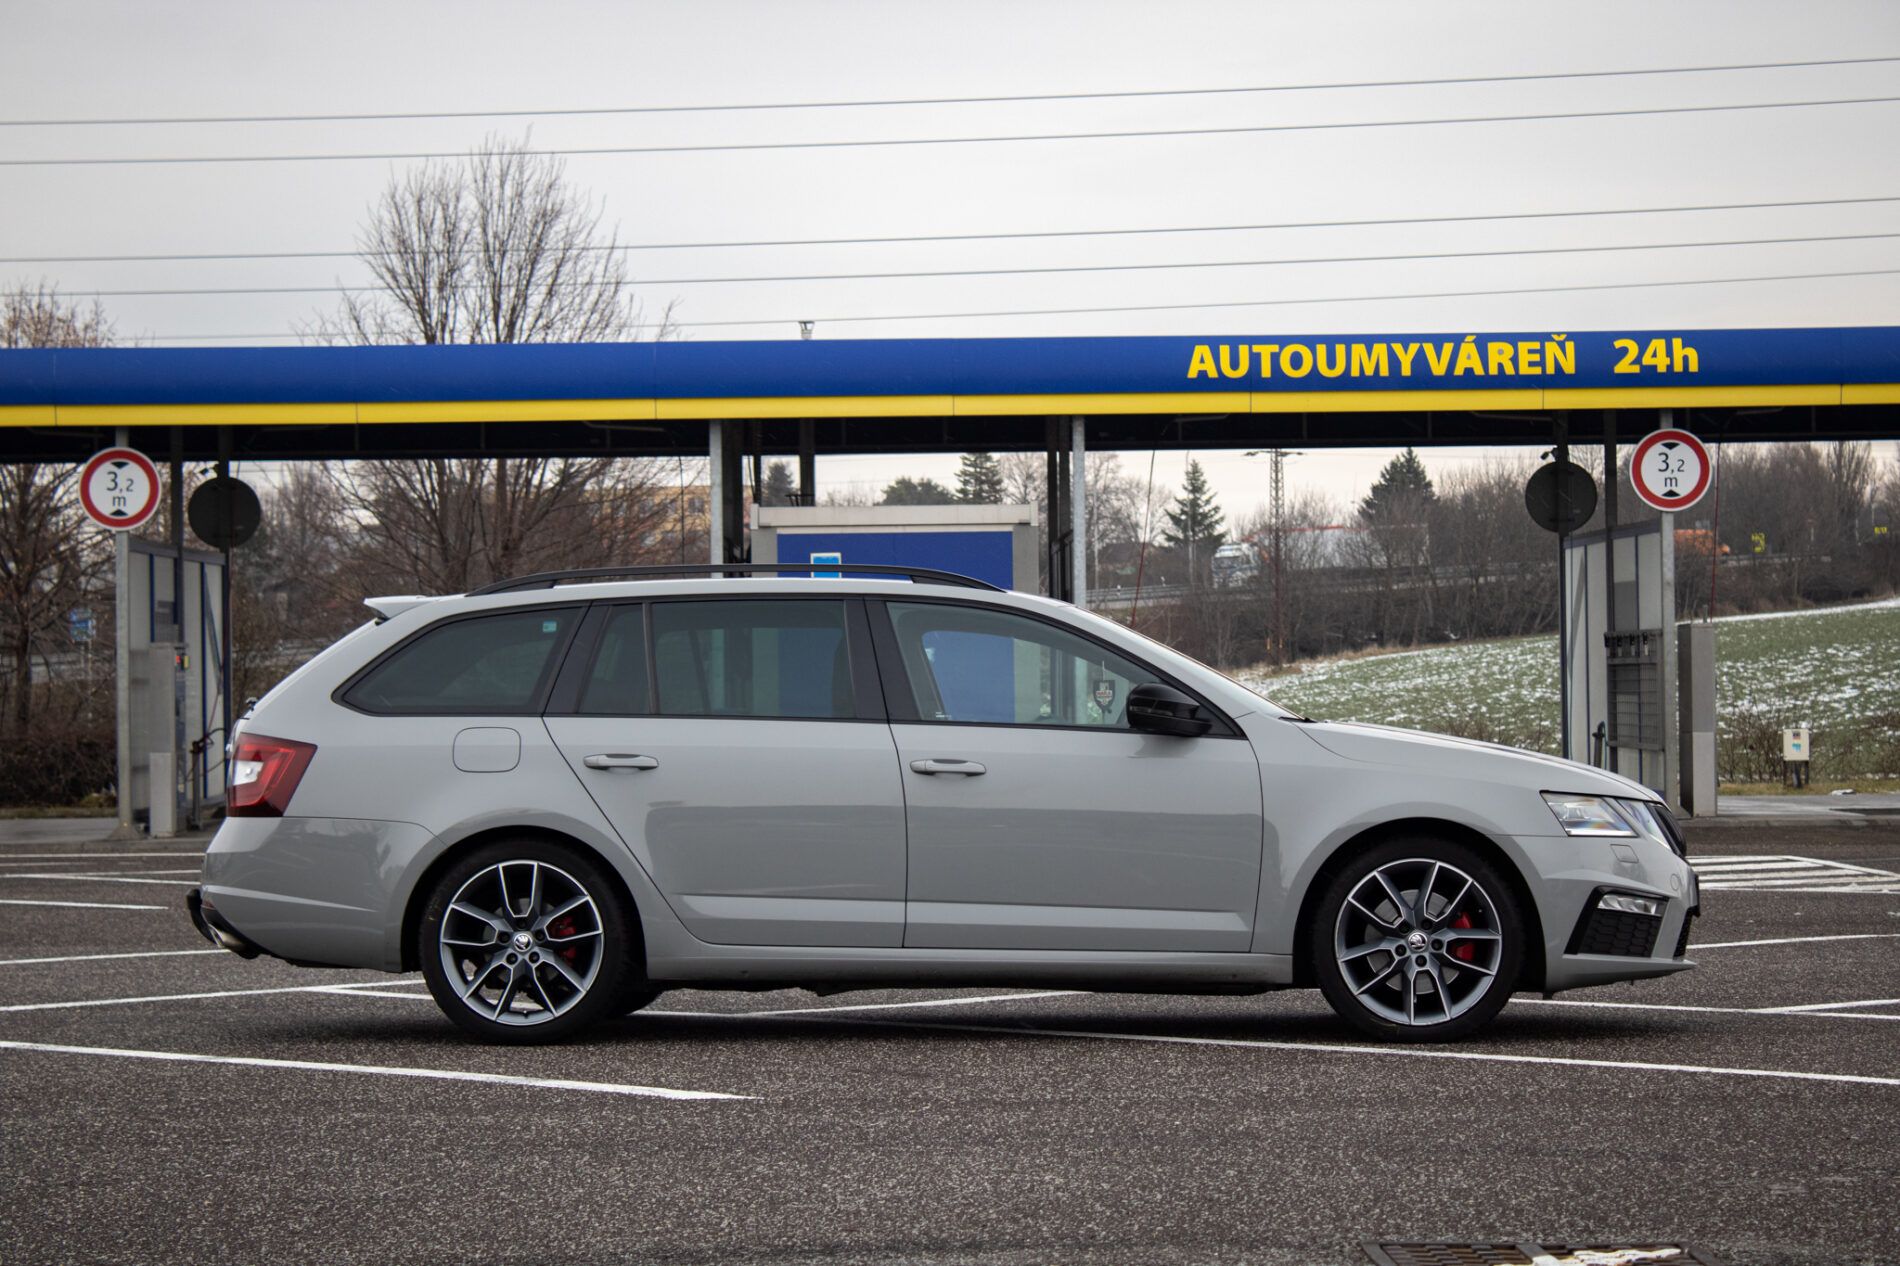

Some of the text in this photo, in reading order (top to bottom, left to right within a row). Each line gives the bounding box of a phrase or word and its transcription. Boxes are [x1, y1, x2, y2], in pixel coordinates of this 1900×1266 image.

[1187, 333, 1699, 379] AUTOUMYVÁREŇ 24h
[1658, 452, 1685, 474] 3,2
[106, 471, 134, 493] 3,2
[1664, 476, 1678, 488] m
[112, 495, 127, 507] m
